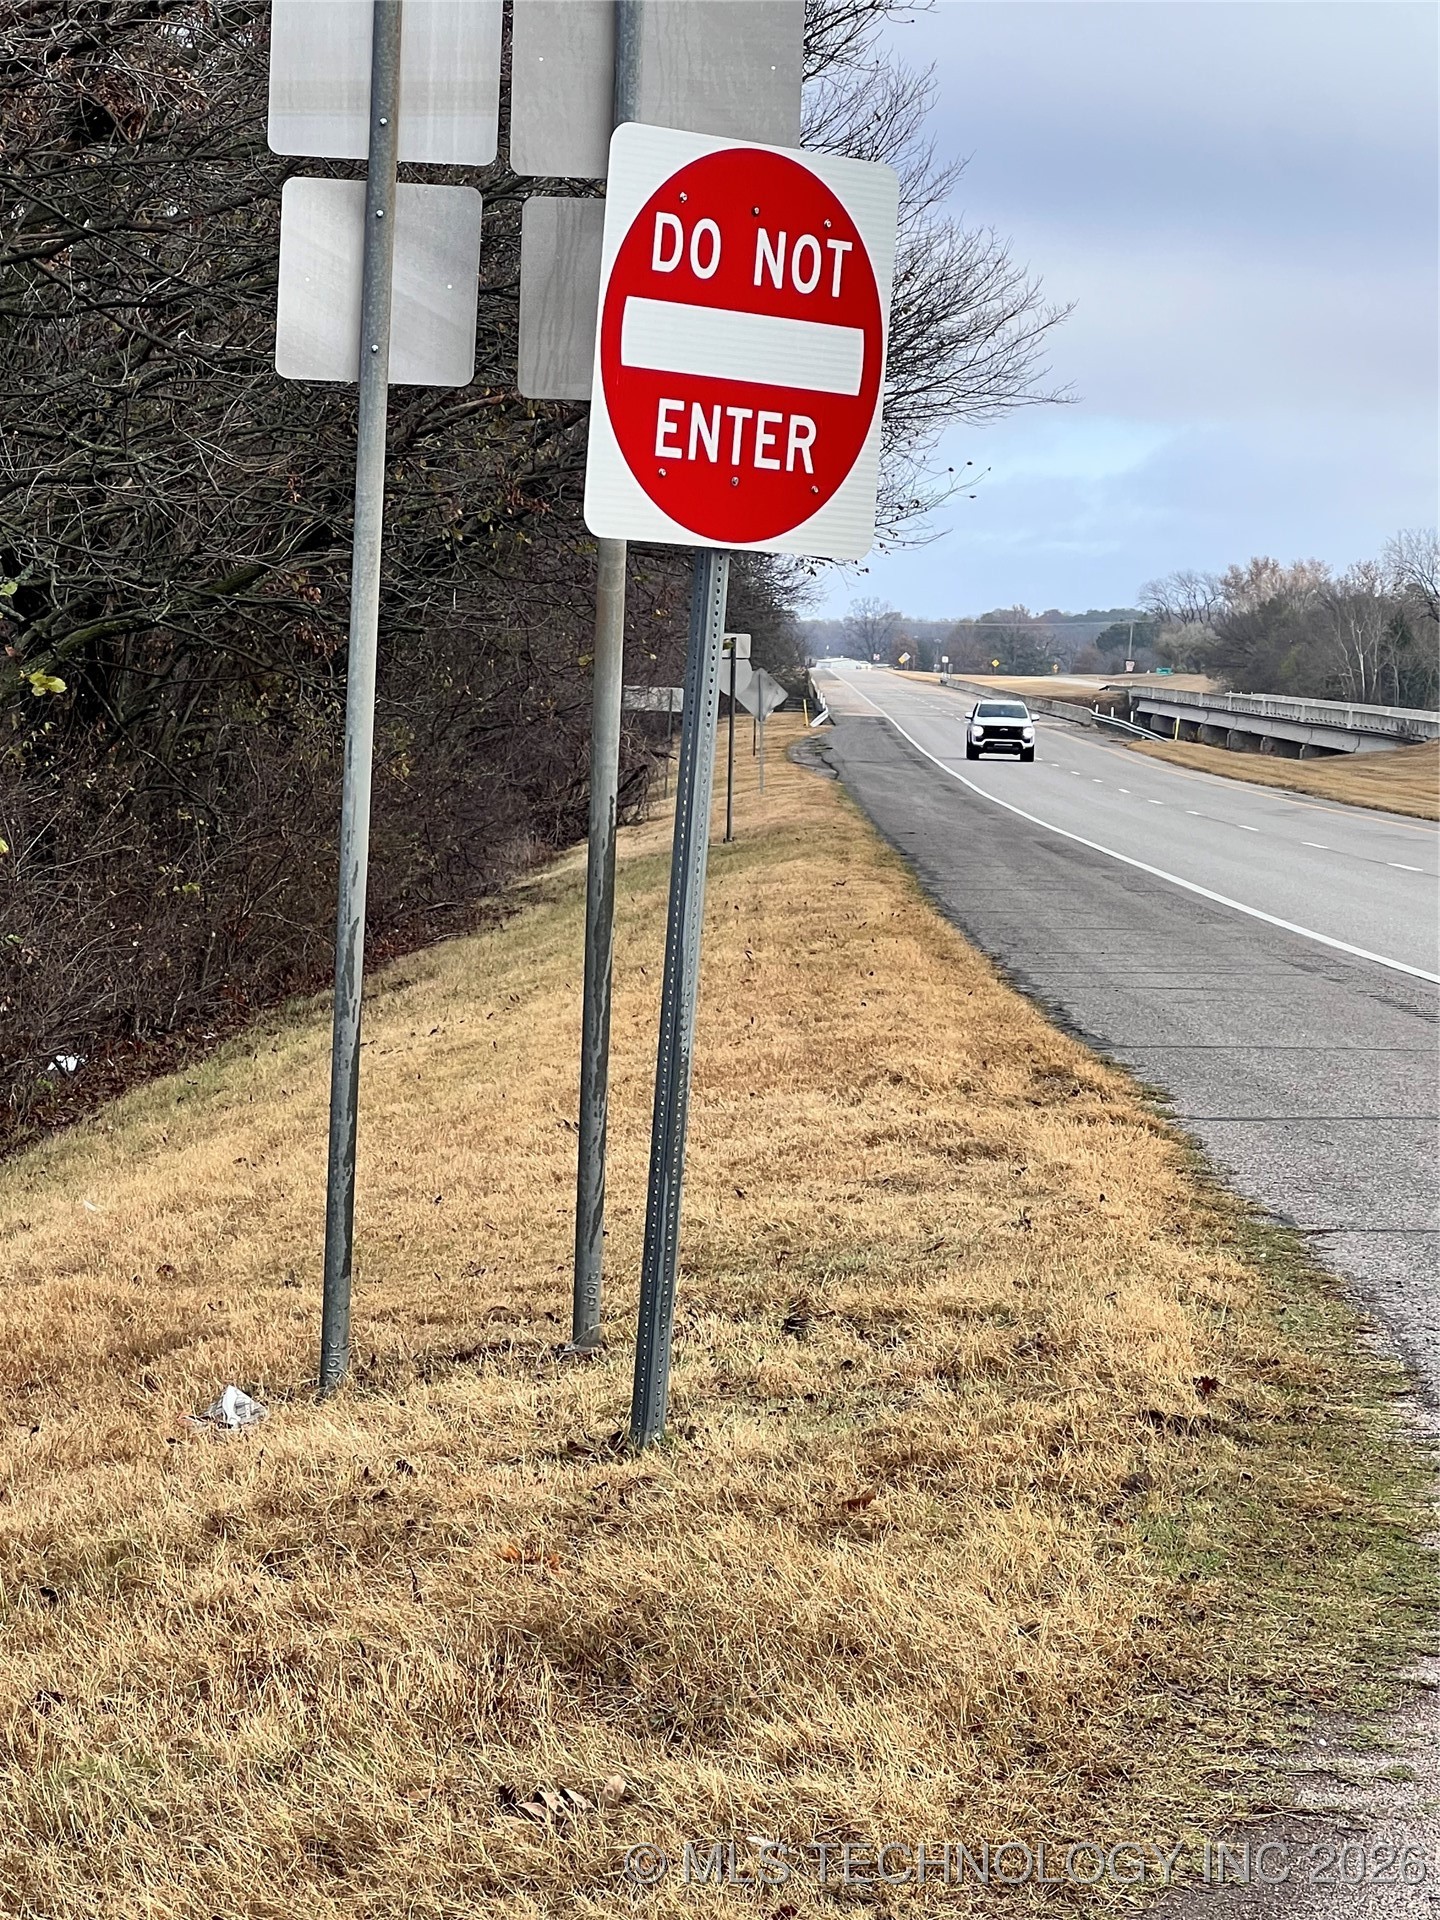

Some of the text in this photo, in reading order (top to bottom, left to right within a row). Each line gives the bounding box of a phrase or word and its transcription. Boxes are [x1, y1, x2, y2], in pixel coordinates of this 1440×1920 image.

[651, 211, 853, 298] DO NOT
[654, 397, 817, 474] ENTER
